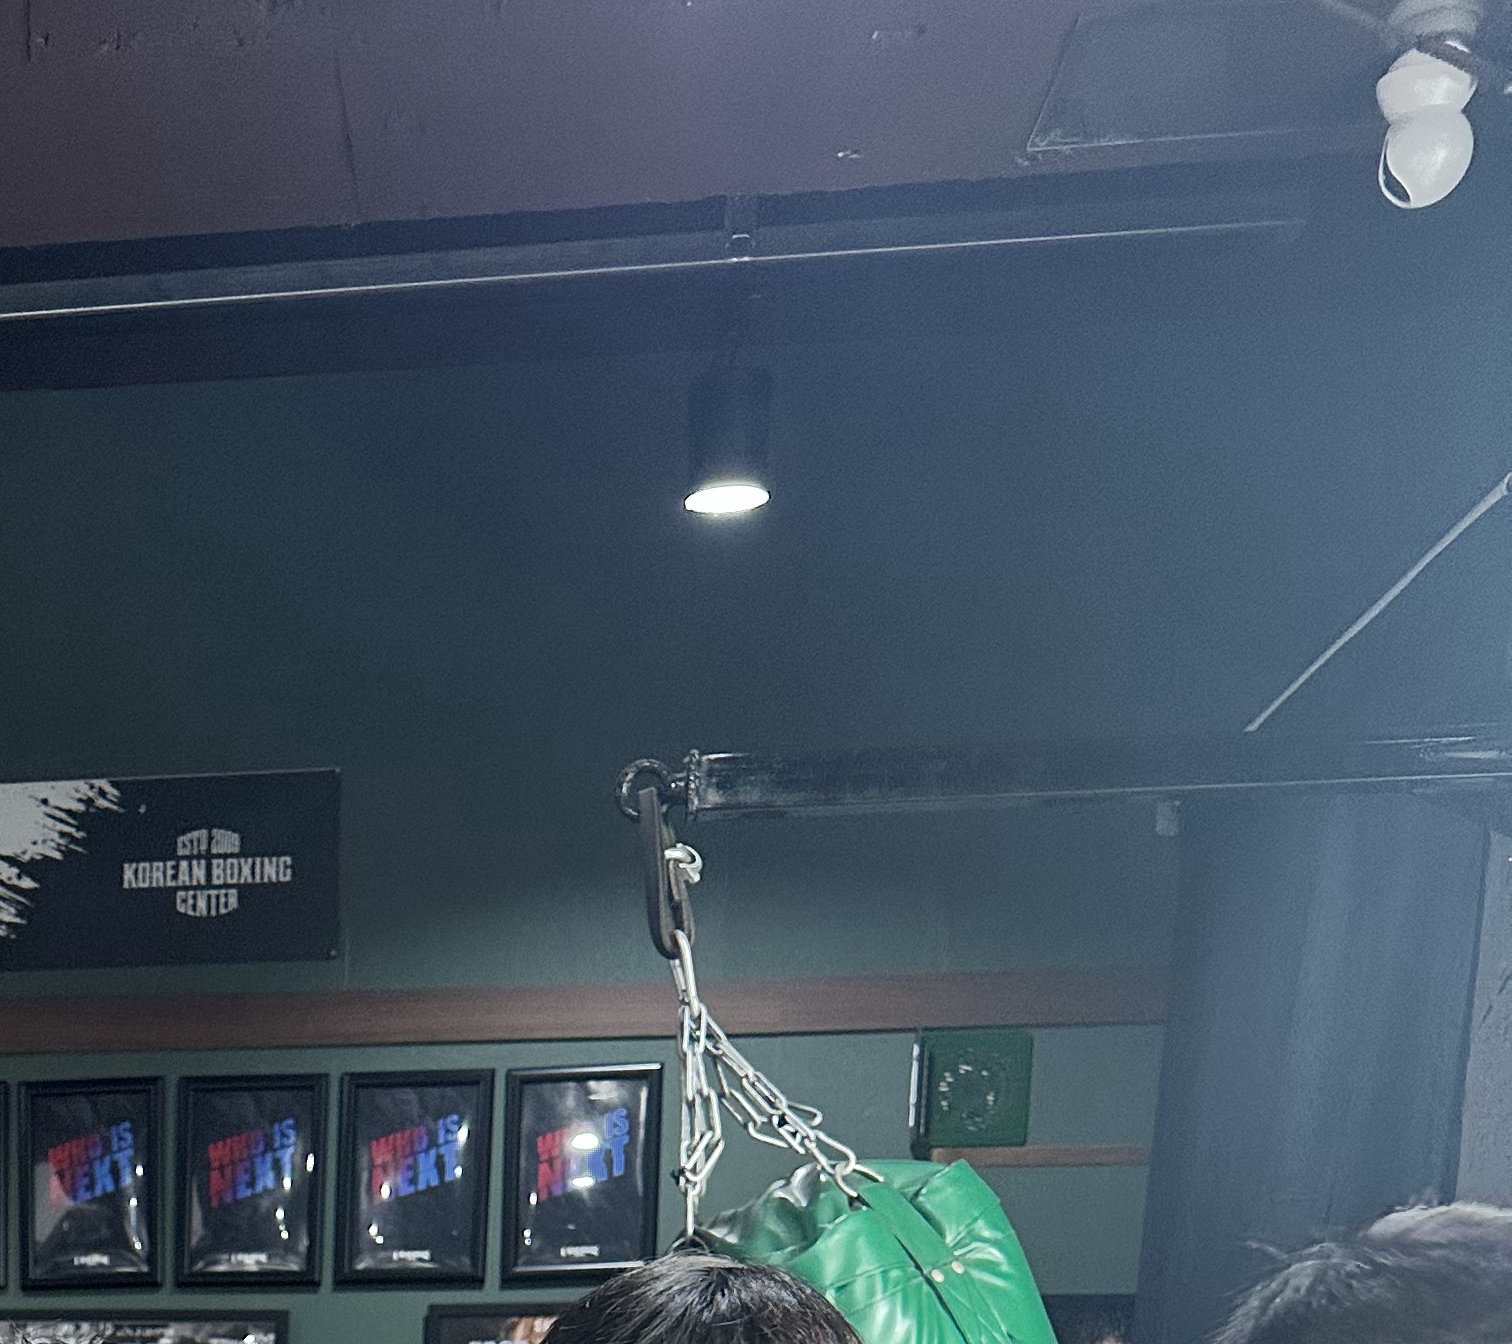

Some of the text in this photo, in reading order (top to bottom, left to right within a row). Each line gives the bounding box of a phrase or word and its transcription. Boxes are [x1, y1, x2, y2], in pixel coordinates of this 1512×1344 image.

[122, 856, 293, 889] KOREAN BOXING
[175, 888, 238, 918] CENTER
[110, 1121, 134, 1151] IS
[273, 1117, 296, 1149] IS
[437, 1113, 460, 1144] IS
[604, 1108, 630, 1139] IS
[209, 1146, 294, 1208] NEXT
[371, 1142, 460, 1205] NEXT
